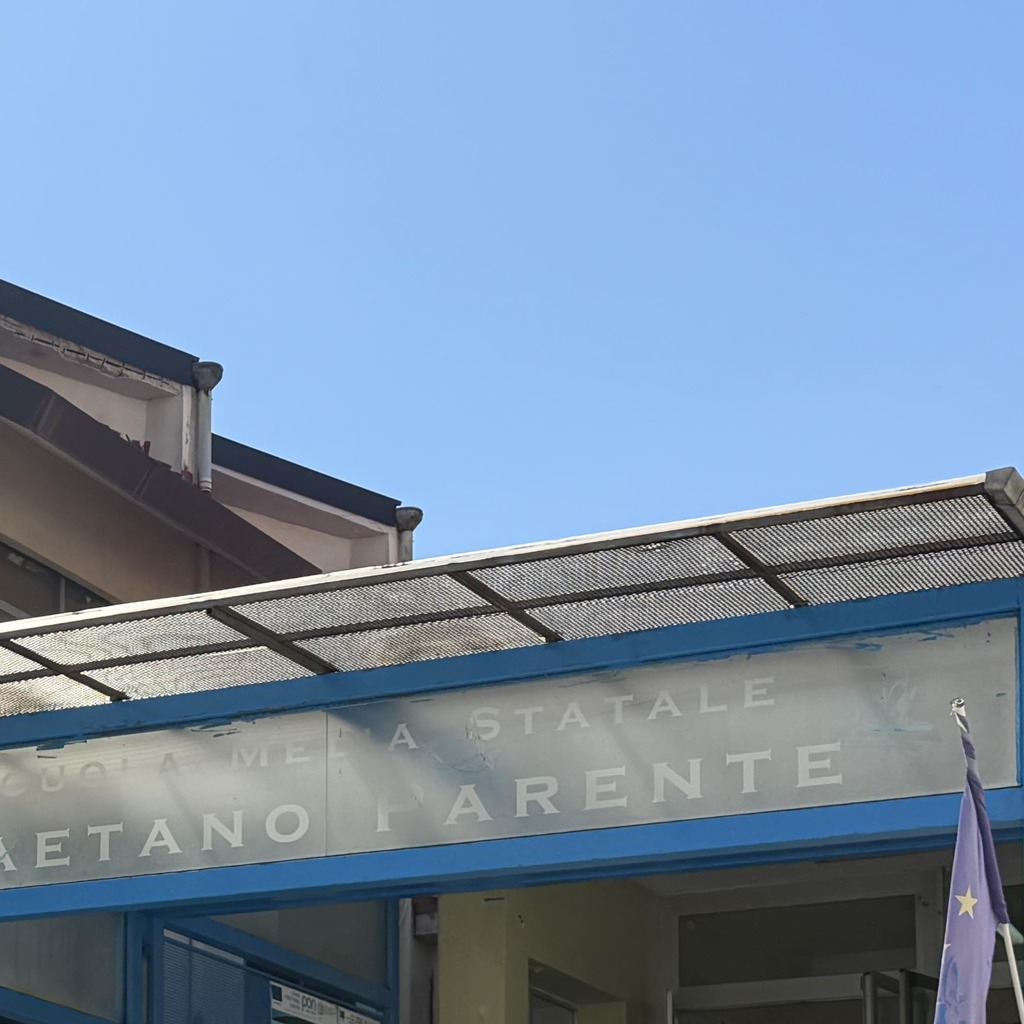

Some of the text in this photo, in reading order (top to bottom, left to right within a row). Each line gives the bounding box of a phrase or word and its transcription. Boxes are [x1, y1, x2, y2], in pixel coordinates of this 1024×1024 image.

[230, 722, 420, 771] MEA
[467, 675, 776, 741] STATALE
[375, 741, 844, 834] PARENTE
